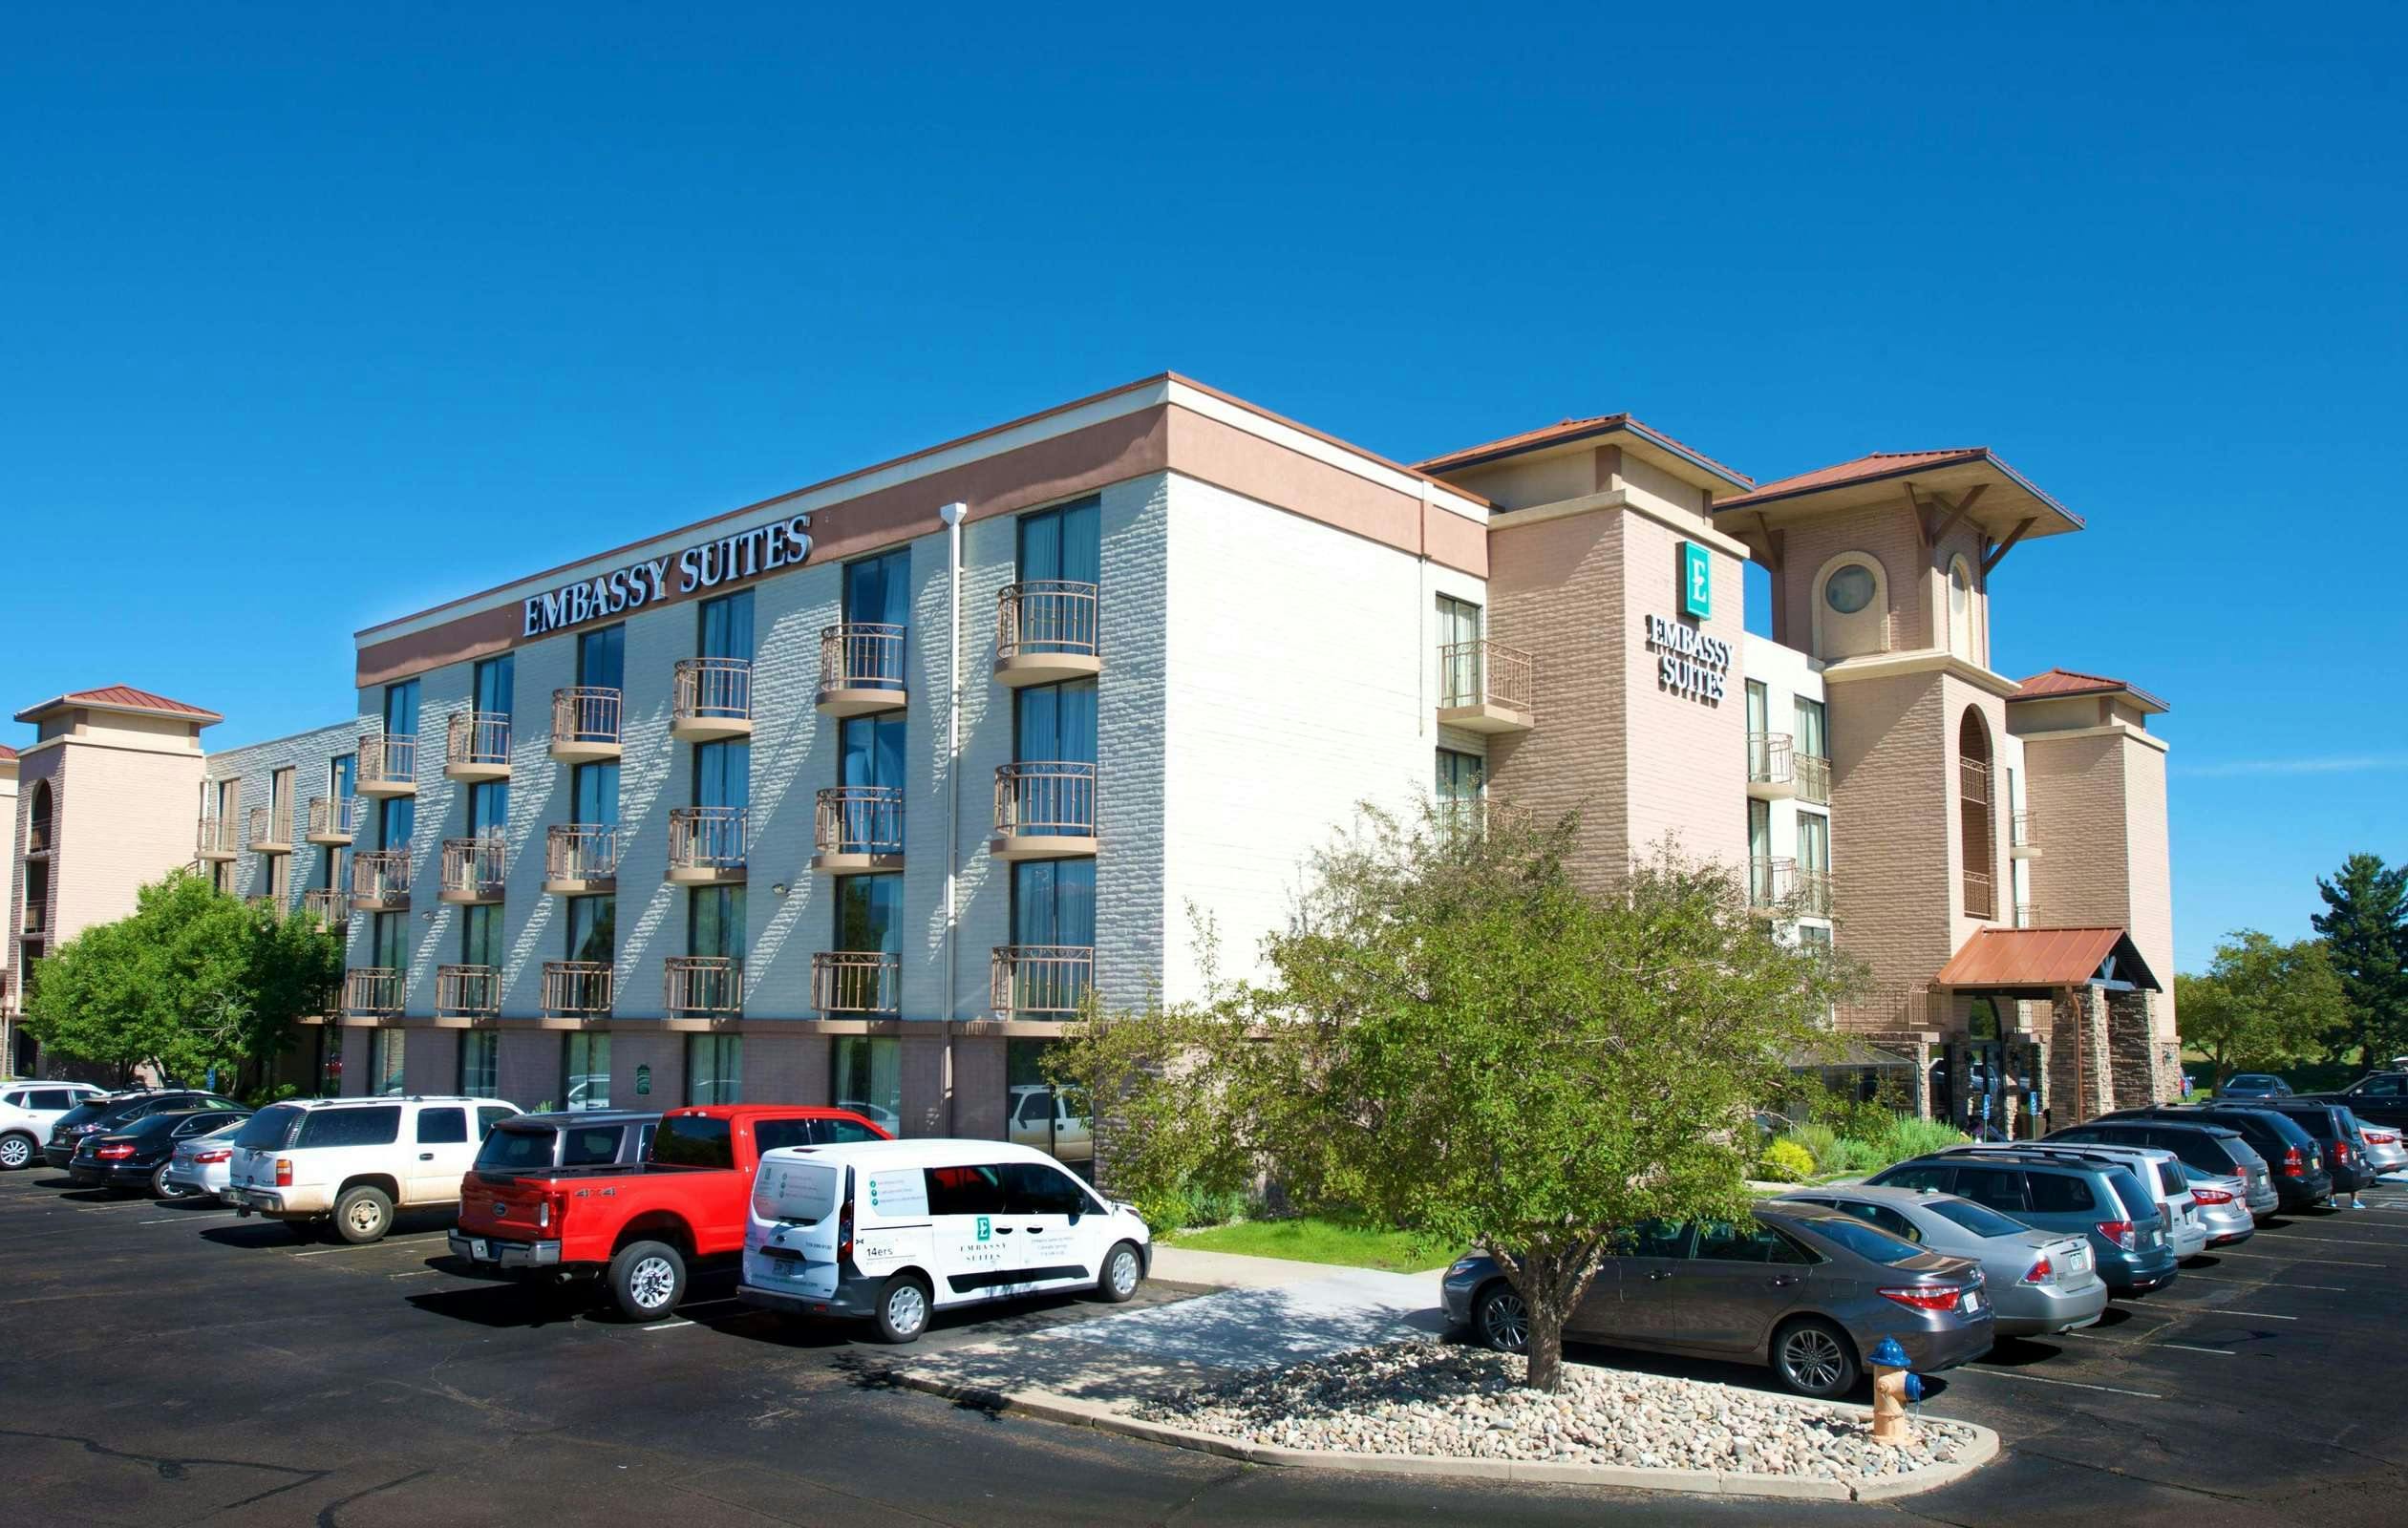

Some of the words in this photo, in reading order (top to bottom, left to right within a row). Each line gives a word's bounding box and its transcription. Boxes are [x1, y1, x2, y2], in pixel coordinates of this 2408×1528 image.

[522, 556, 673, 638] EMBASSY
[680, 515, 814, 593] SUITES
[1648, 614, 1736, 670] EMBASSY
[1660, 654, 1727, 703] SUITES
[866, 1247, 894, 1257] 14ers
[960, 1242, 1007, 1252] EMBASSY
